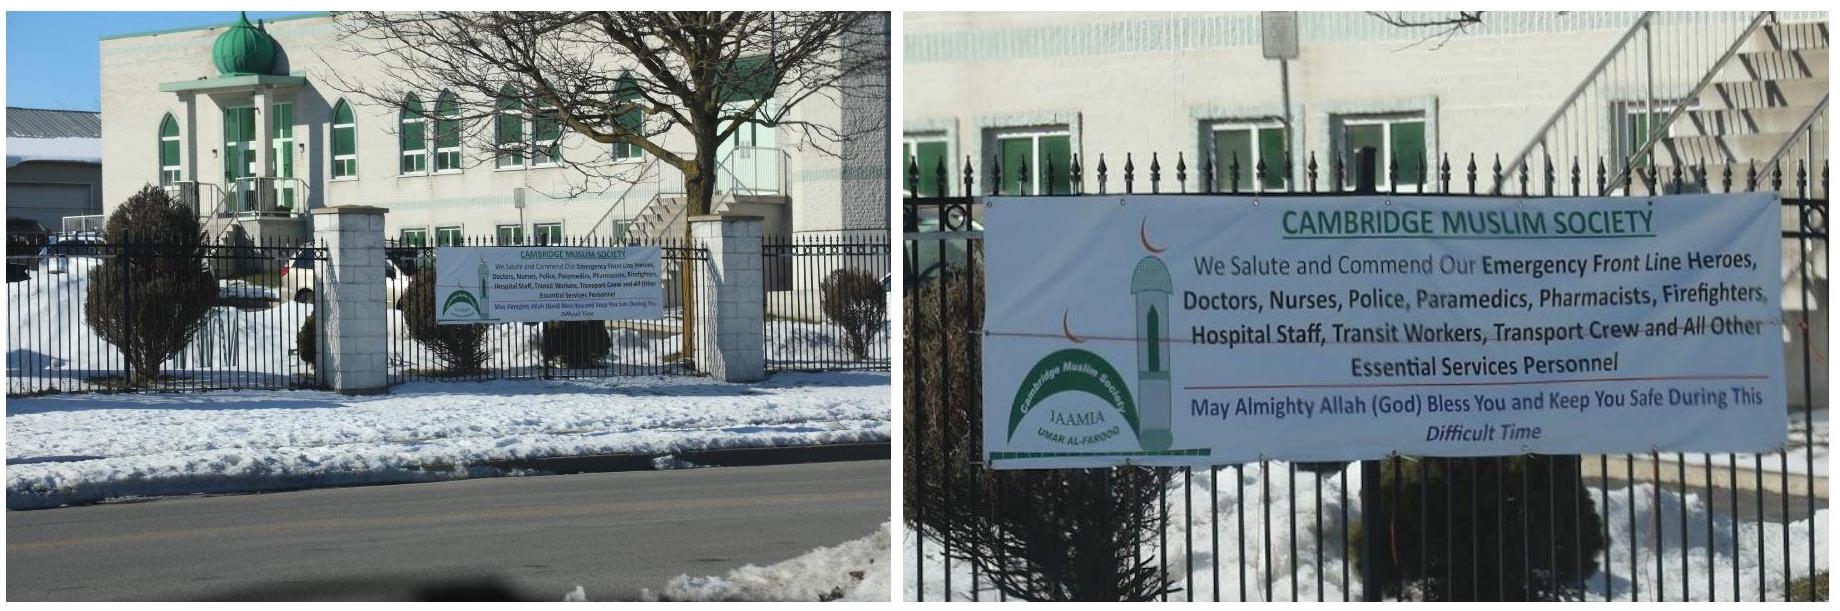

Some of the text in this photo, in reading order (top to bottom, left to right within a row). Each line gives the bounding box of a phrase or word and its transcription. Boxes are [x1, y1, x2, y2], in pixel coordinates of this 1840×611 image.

[1282, 209, 1654, 235] CAMBRIDGE MUSLIM SOCIETY
[597, 250, 626, 258] SOCIETY
[1194, 250, 1758, 279] We Salute and Commend Our Emergency Front Line Heroes,
[1183, 282, 1768, 314] Doctors, Nurses, Police, Paramedics, Pharmacists, Firefighters,
[1192, 315, 1763, 349] Hospital Staff, Transit Workers, Transport Crew and All Other
[1352, 352, 1619, 377] Essential Services Personnel
[1020, 361, 1127, 414] Cambridge Muslim Society
[1191, 386, 1763, 420] May Almighty Allah (God) Bless You and Keep You Safe During This
[1038, 427, 1066, 444] UMAR
[1426, 422, 1542, 443] Difficult Time
